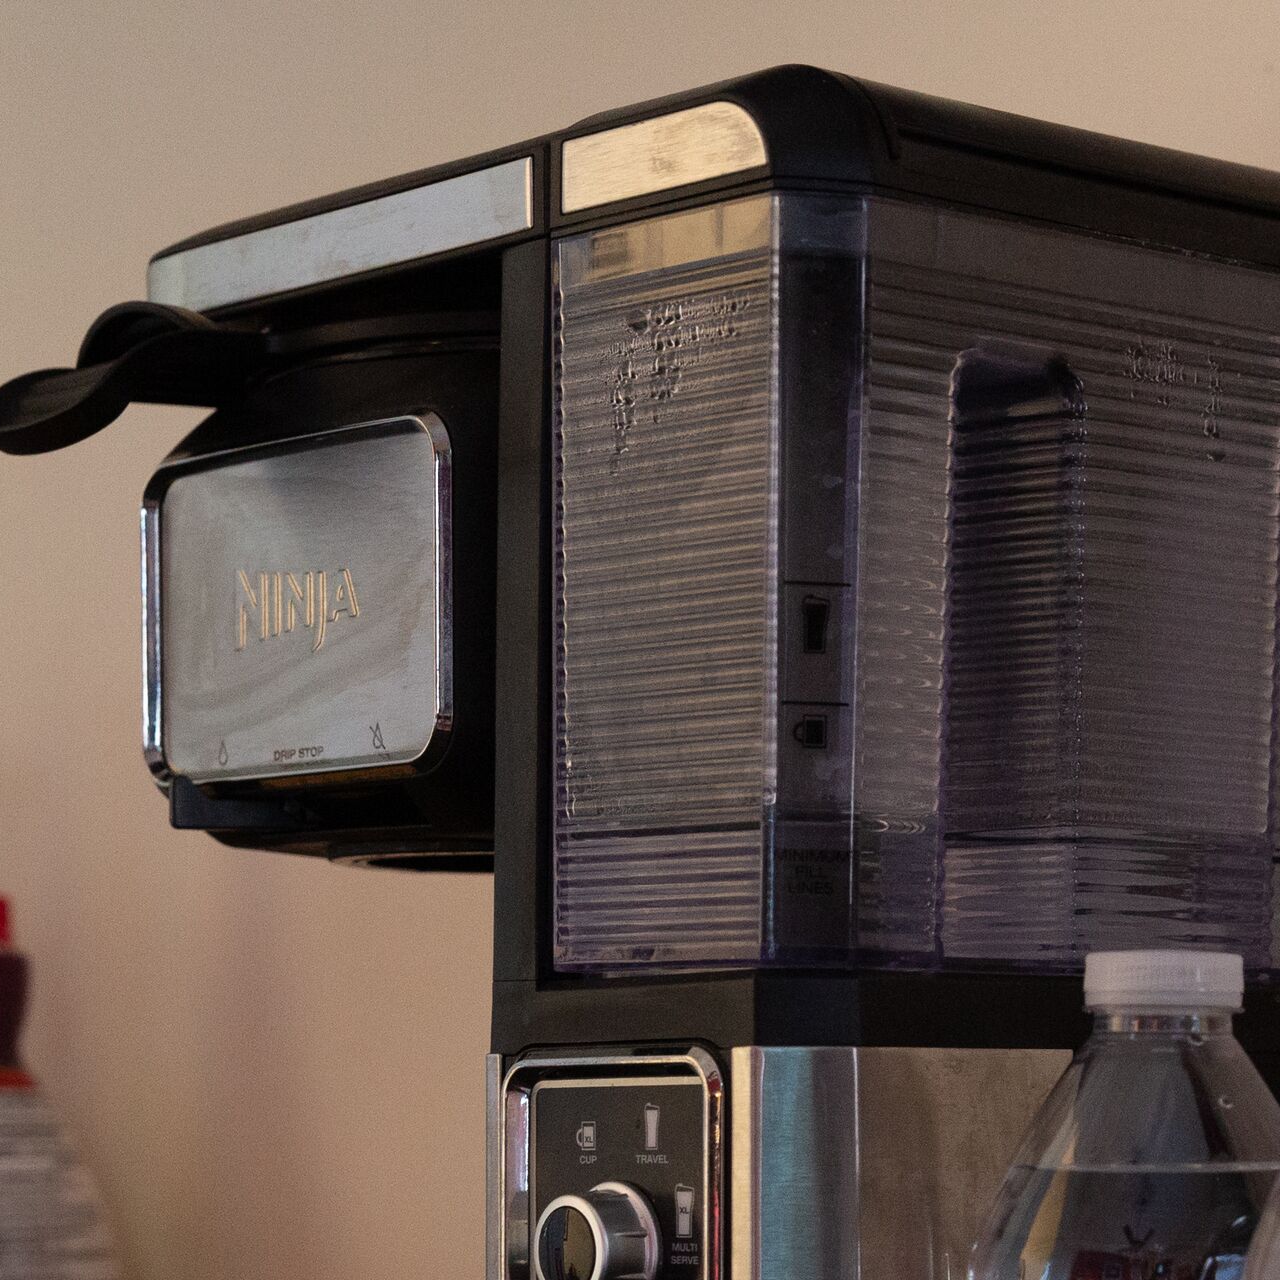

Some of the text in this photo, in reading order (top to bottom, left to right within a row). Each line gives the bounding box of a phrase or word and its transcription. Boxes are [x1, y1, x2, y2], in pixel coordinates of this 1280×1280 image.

[235, 568, 360, 653] NINJA
[273, 746, 324, 761] DRIP STOP
[787, 881, 833, 895] LINES
[584, 1136, 594, 1144] XL
[579, 1154, 598, 1165] CUP
[635, 1154, 669, 1164] TRAVEL
[679, 1206, 689, 1215] XL
[672, 1242, 698, 1252] MULTI
[671, 1255, 700, 1265] SERVE
